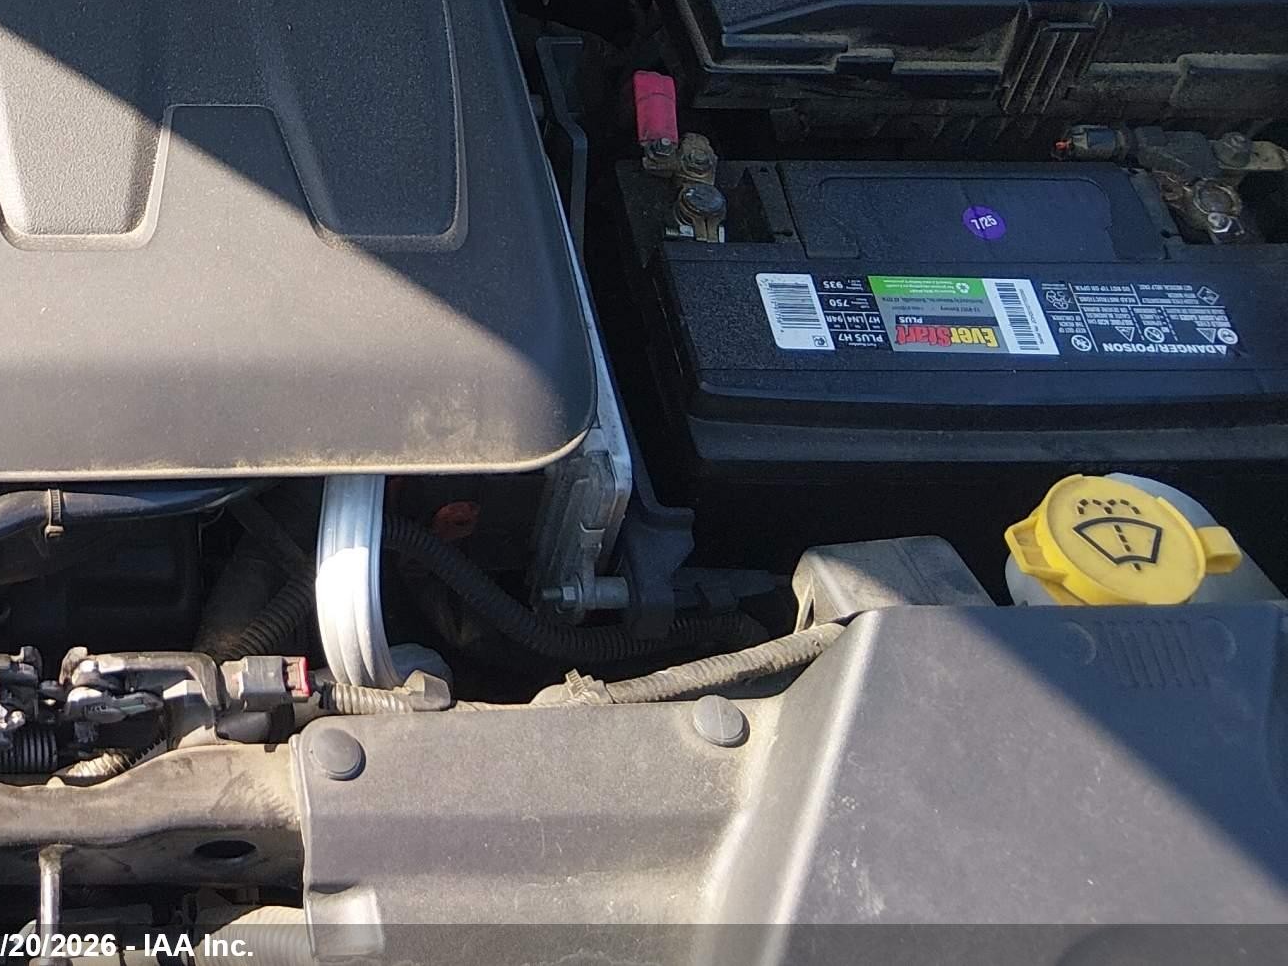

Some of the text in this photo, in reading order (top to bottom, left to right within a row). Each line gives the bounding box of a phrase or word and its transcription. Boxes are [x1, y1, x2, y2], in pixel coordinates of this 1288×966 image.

[970, 214, 998, 230] 7/25
[822, 280, 844, 289] 935
[828, 298, 850, 307] 750
[846, 315, 865, 324] LN4
[868, 315, 881, 324] H7
[898, 315, 924, 324] PLUS
[838, 333, 884, 343] PLUS H7
[895, 325, 1001, 348] EverStart
[1102, 342, 1217, 354] DANGER/POISON
